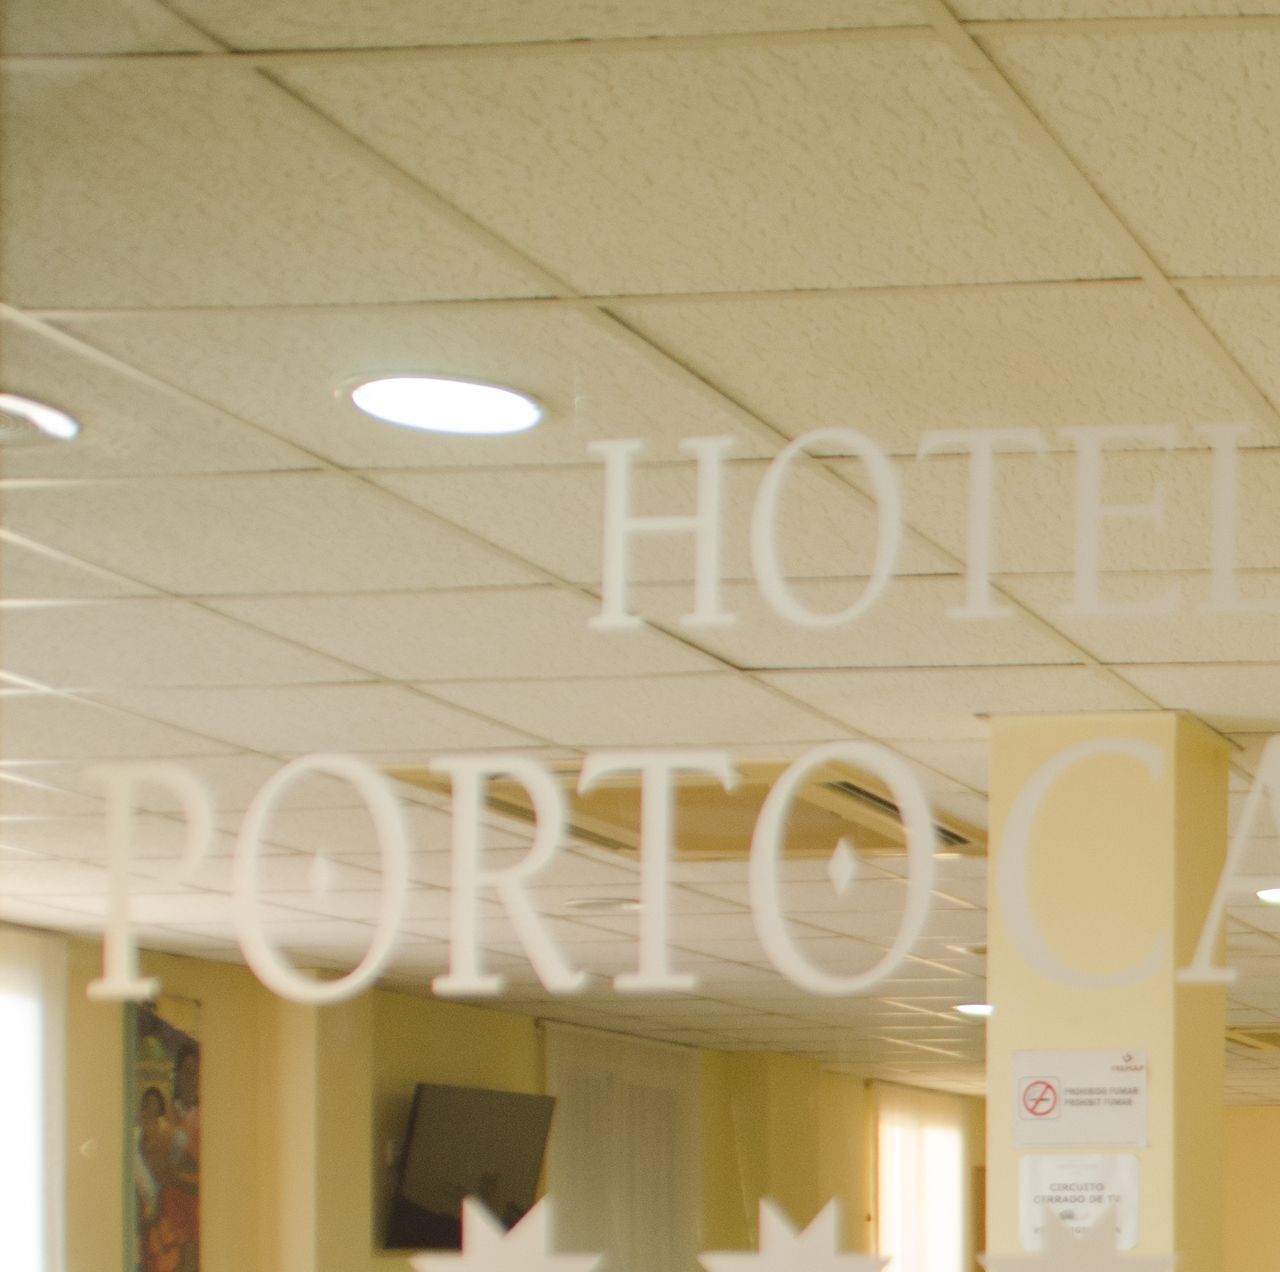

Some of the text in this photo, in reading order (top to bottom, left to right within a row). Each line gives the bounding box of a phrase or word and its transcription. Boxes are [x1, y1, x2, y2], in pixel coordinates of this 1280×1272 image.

[86, 740, 938, 1003] PORTO
[1049, 1182, 1104, 1191] CIRCUITO
[1033, 1194, 1086, 1204] CERRADO
[1088, 1194, 1103, 1203] DE
